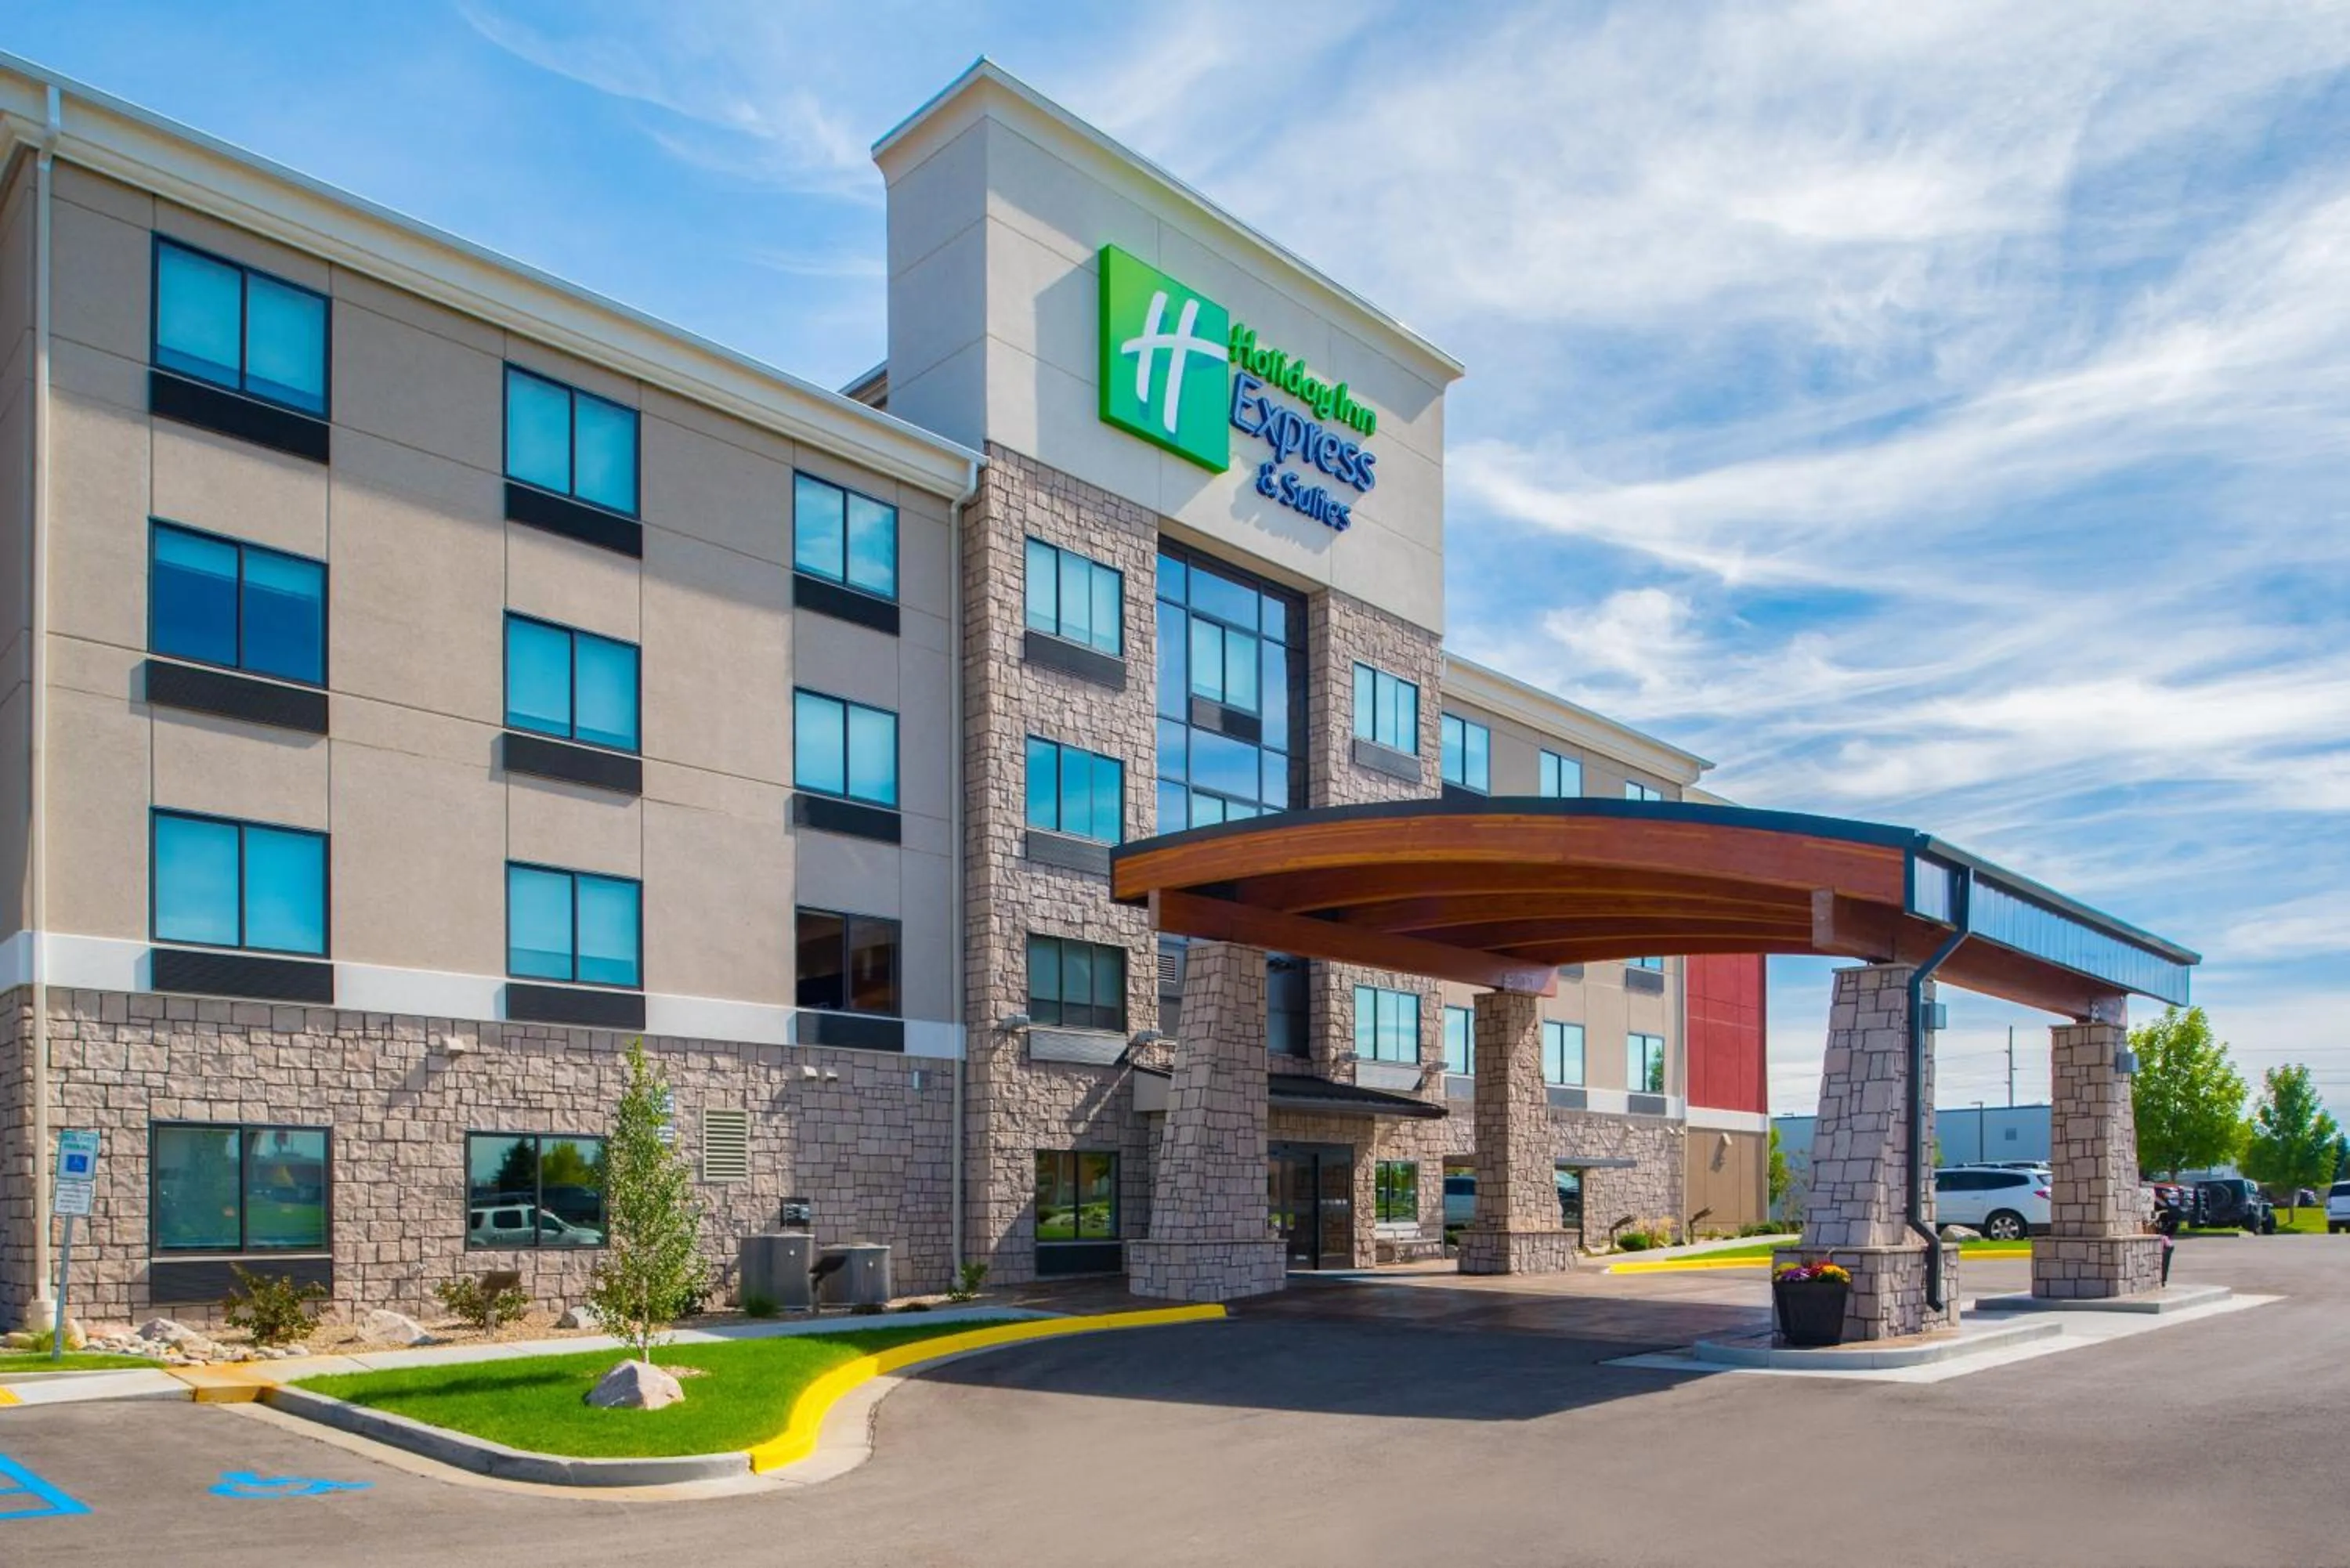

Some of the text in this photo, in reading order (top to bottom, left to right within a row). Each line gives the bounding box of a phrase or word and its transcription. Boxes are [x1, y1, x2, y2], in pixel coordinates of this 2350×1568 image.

[1229, 323, 1376, 436] Holiday Inn
[1230, 372, 1376, 492] Express
[1256, 462, 1351, 531] & Suites
